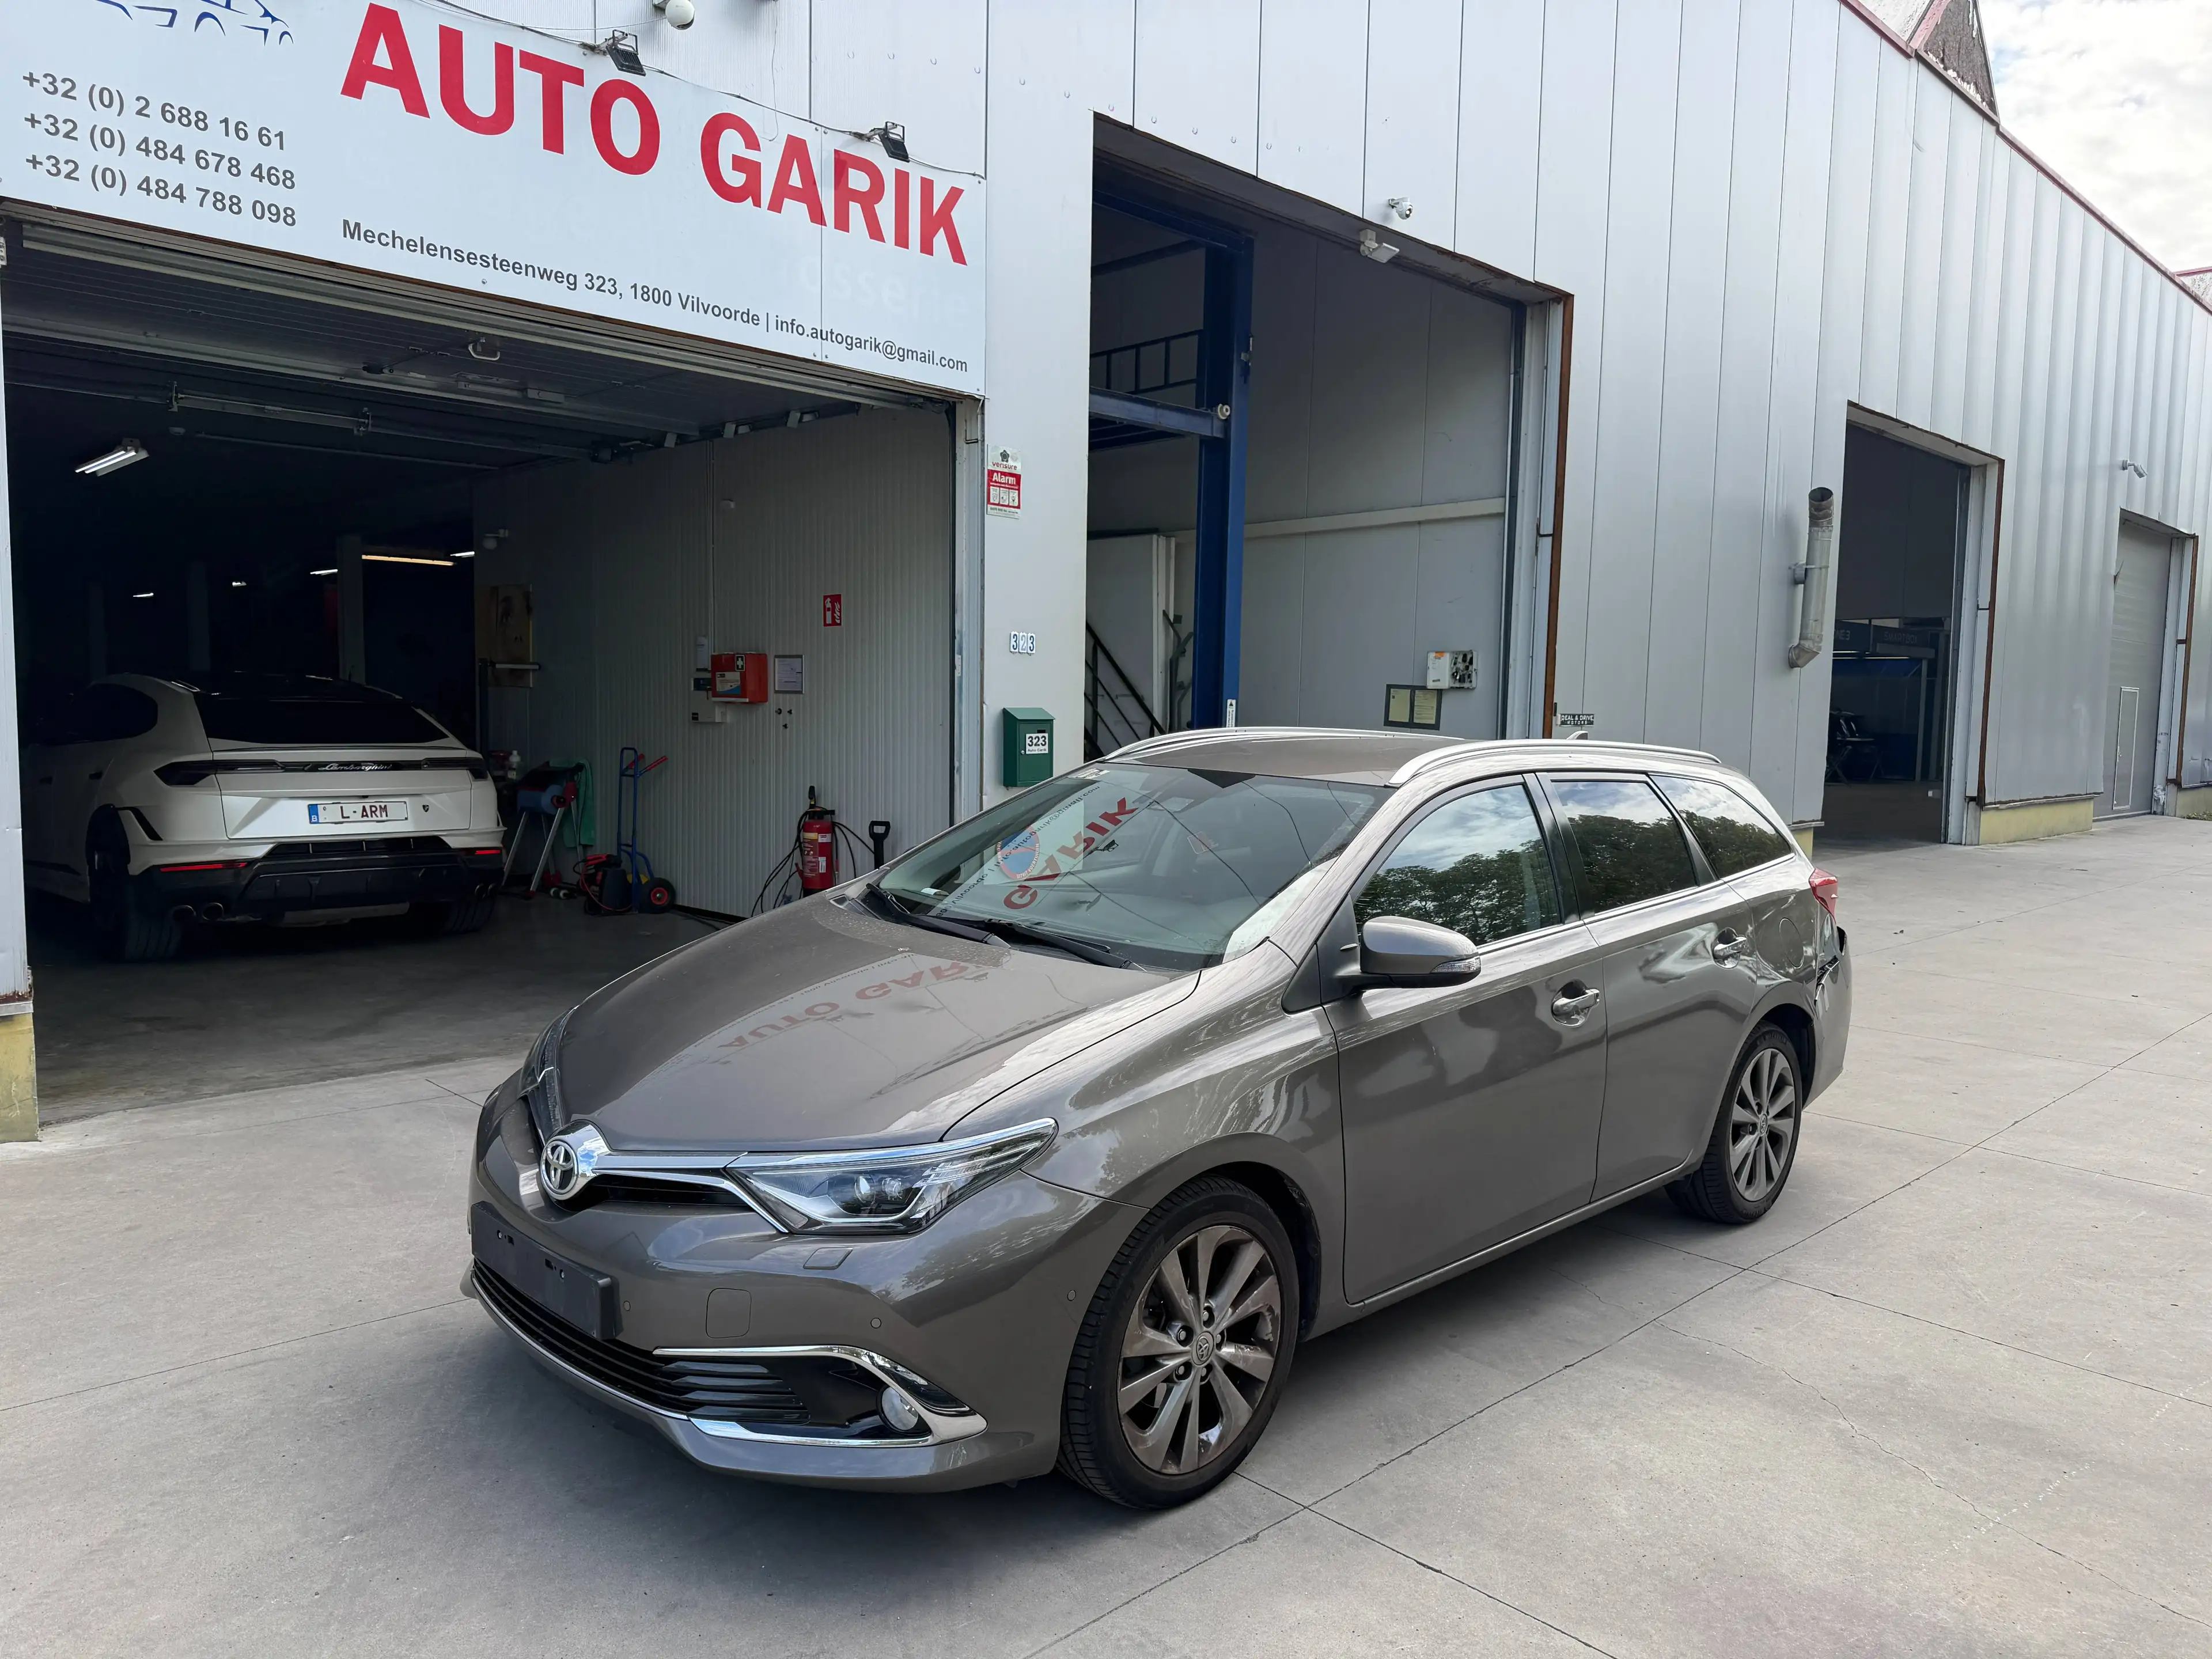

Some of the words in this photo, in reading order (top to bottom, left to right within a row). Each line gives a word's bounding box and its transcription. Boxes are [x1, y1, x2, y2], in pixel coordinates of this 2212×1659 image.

[23, 71, 77, 101] +32
[88, 84, 124, 117] (0)
[135, 96, 150, 119] 2
[161, 102, 209, 131] 688
[219, 117, 249, 141] 16
[257, 126, 284, 151] 61
[342, 3, 660, 175] AUTO
[700, 113, 968, 266] GARIK
[24, 113, 78, 141] +32
[89, 124, 127, 157] (0)
[135, 136, 185, 165] 484
[195, 149, 241, 177] 678
[250, 162, 296, 190] 468
[25, 154, 79, 182] +32
[91, 164, 127, 196] (0)
[137, 176, 187, 204] 484
[196, 187, 243, 215] 788
[252, 200, 296, 226] 098
[343, 219, 578, 291] Mechelensesteenweg
[584, 272, 623, 300] 323,
[630, 283, 672, 306] 1800
[677, 292, 760, 326] Vilvoorde
[775, 319, 968, 373] info.autogarik@gmail.com
[993, 472, 1016, 485] Alarm
[1013, 634, 1035, 652] 323
[1028, 735, 1047, 747] 323
